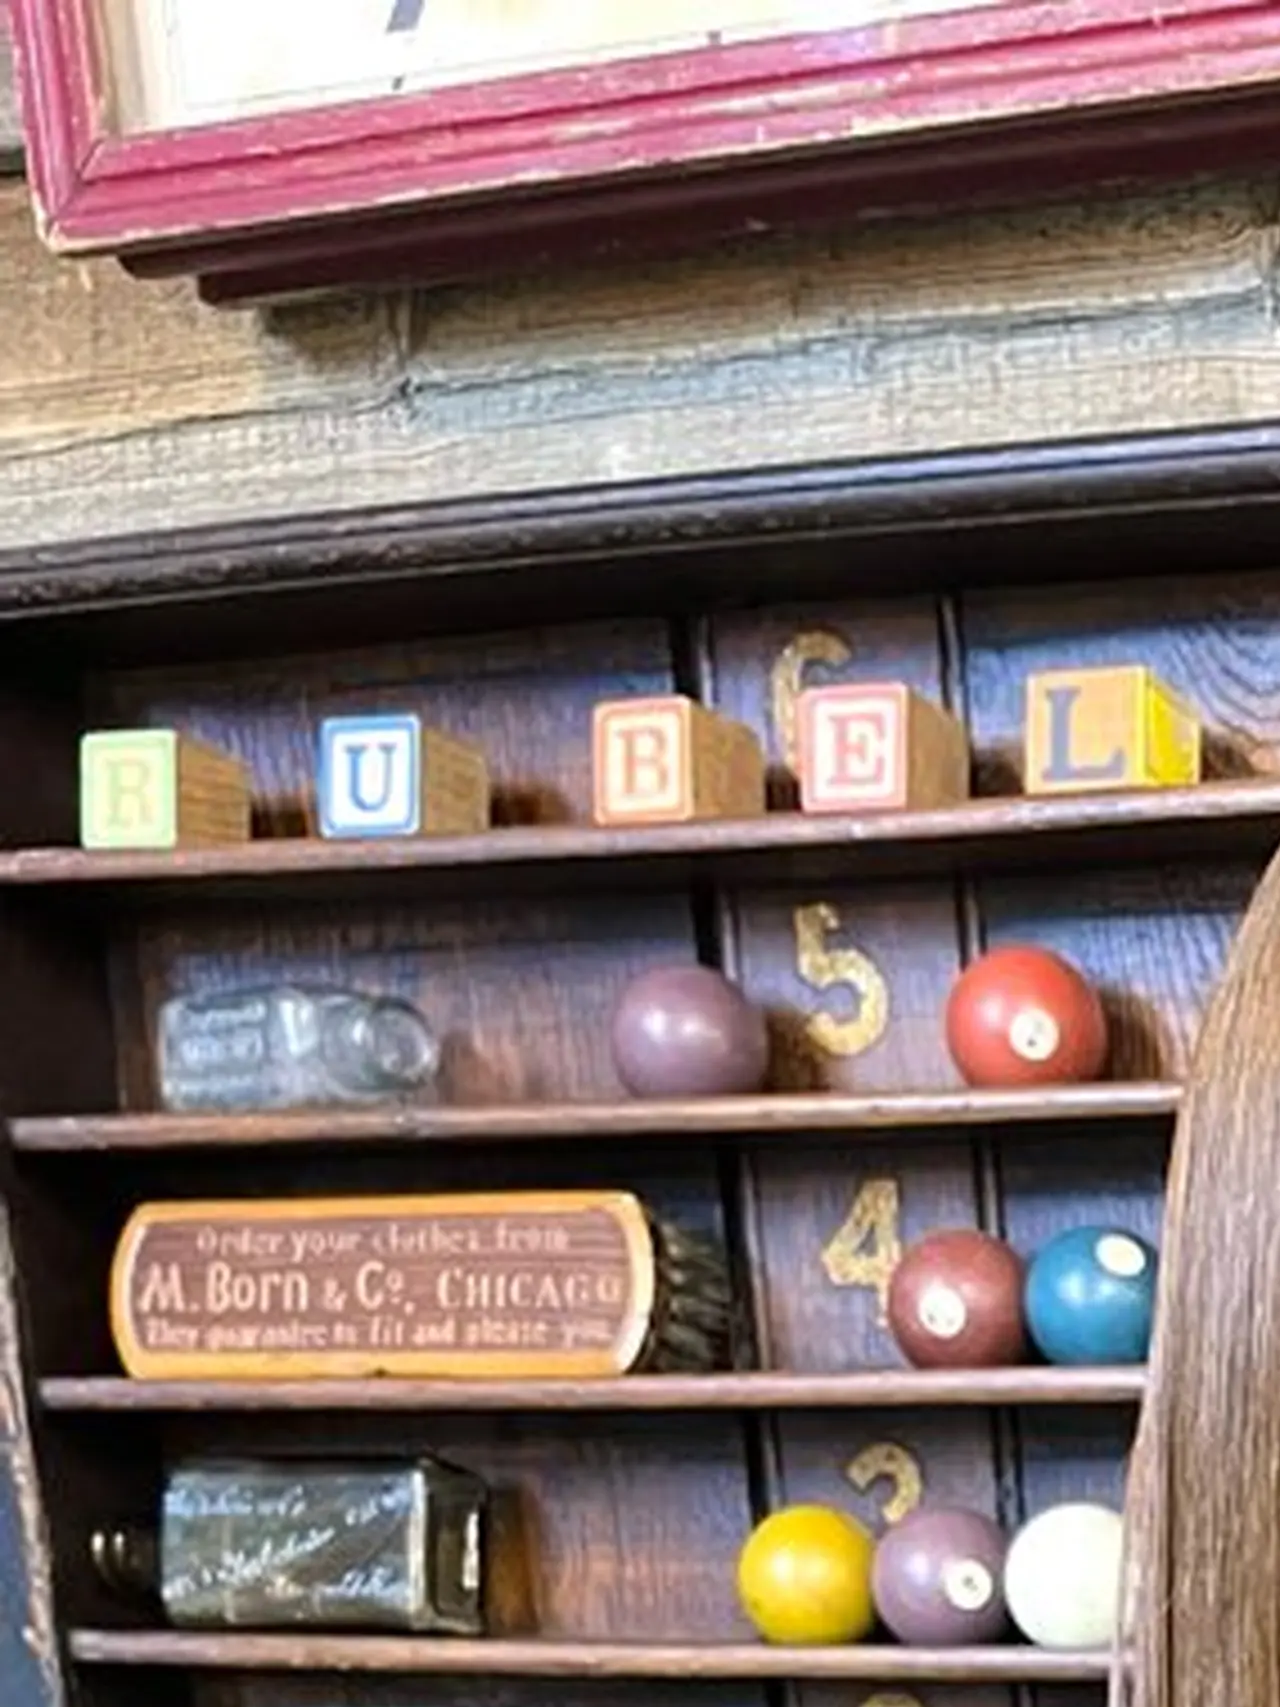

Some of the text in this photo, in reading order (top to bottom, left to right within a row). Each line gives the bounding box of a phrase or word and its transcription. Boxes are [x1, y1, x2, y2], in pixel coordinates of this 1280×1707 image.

[104, 756, 152, 829] R
[344, 743, 397, 812] U
[615, 726, 669, 798] B
[826, 713, 885, 786] E
[1041, 685, 1125, 783] L
[793, 902, 889, 1056] 5
[140, 1262, 200, 1314] M.
[206, 1260, 310, 1314] Born
[323, 1277, 347, 1313] &
[436, 1264, 623, 1310] CHICAGO
[196, 1222, 284, 1257] Order
[290, 1228, 362, 1264] your
[495, 1219, 570, 1251] from
[821, 1179, 900, 1326] 4
